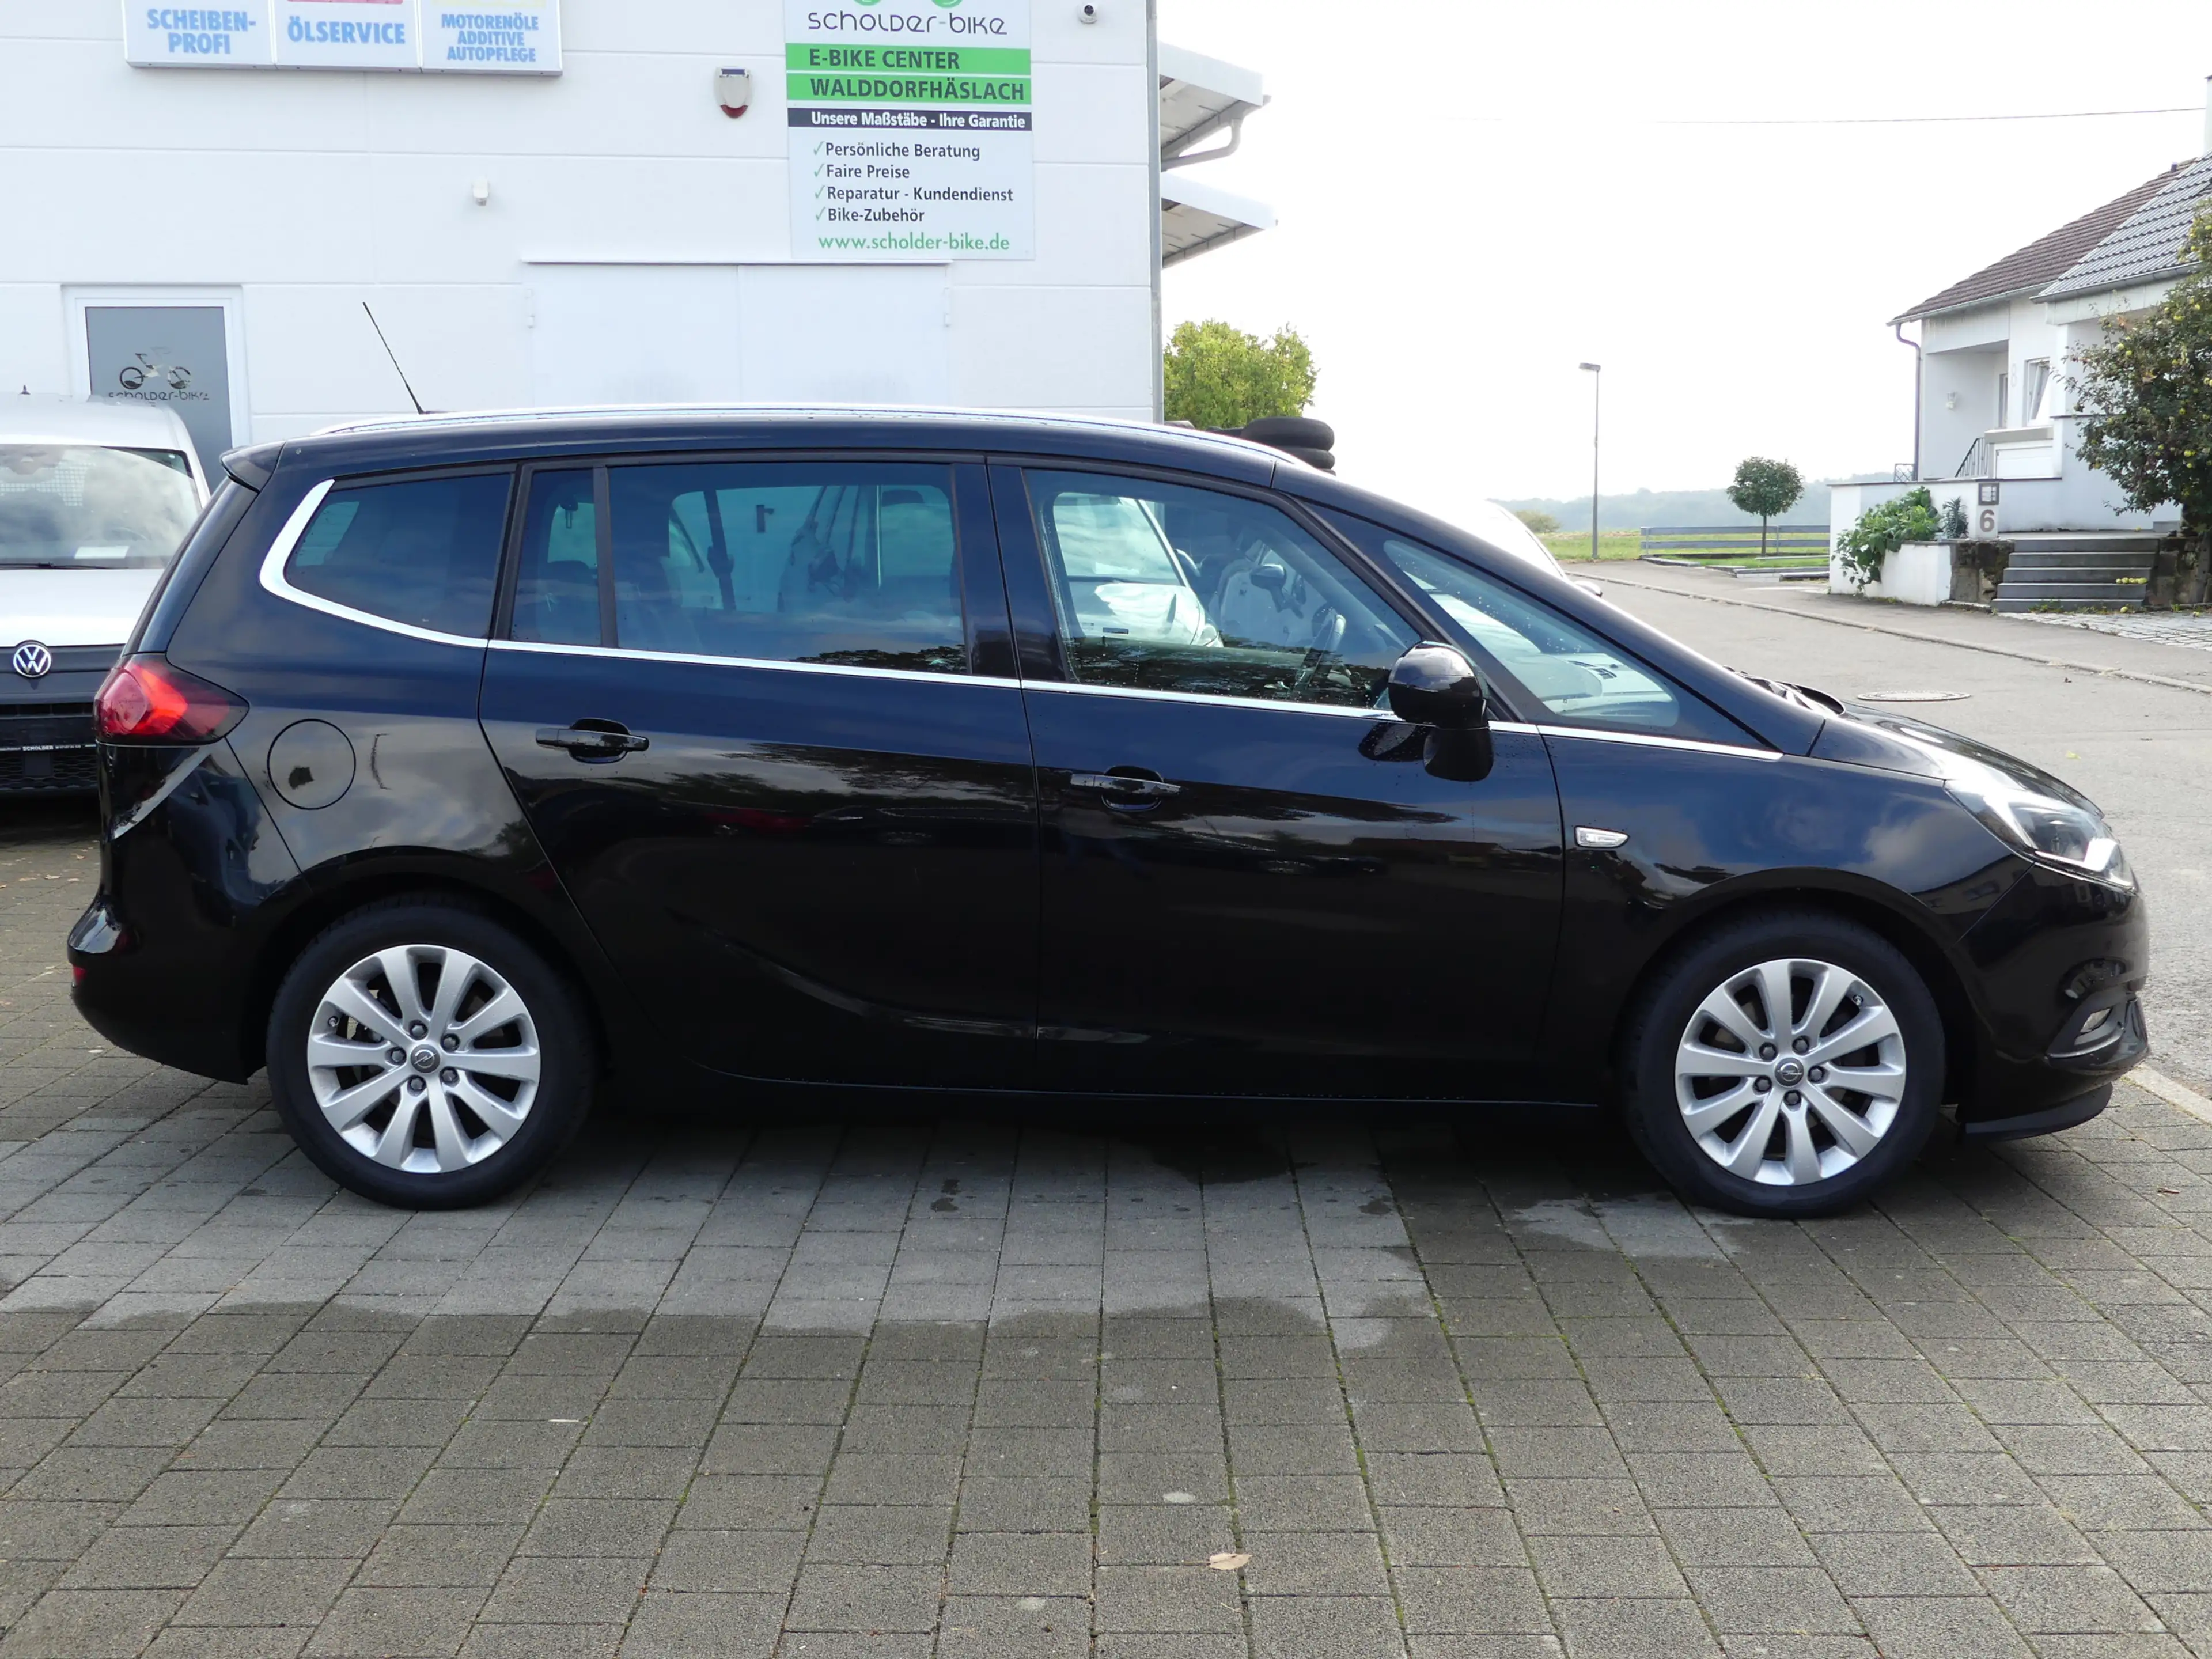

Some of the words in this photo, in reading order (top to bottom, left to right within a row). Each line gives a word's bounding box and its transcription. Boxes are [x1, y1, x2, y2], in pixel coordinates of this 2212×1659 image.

[147, 9, 256, 32] SCHEIBEN-
[288, 16, 406, 44] ÖLSERVICE
[441, 12, 539, 31] MOTORENÖLE
[168, 33, 230, 54] PROFI
[458, 31, 525, 47] ADDITIVE
[446, 46, 536, 62] AUTOPFLEGE
[809, 48, 876, 67] E-BIKE
[882, 50, 960, 69] CENTER
[810, 77, 1025, 100] WALDDORFHÄSLACH
[811, 111, 858, 126] Unsere
[861, 112, 927, 127] Maßstäbe
[939, 113, 965, 127] Ihre
[968, 114, 1025, 128] Garantie
[825, 142, 910, 157] Persönliche
[914, 144, 980, 161] Beratung
[827, 164, 862, 178] Faire
[867, 165, 910, 179] Preise
[827, 186, 900, 203] Reparatur
[914, 187, 1013, 202] Kundendienst
[828, 207, 925, 222] Bike-Zubehör
[818, 232, 1010, 251] www.scholder-bike.de
[1979, 509, 1995, 532] 6
